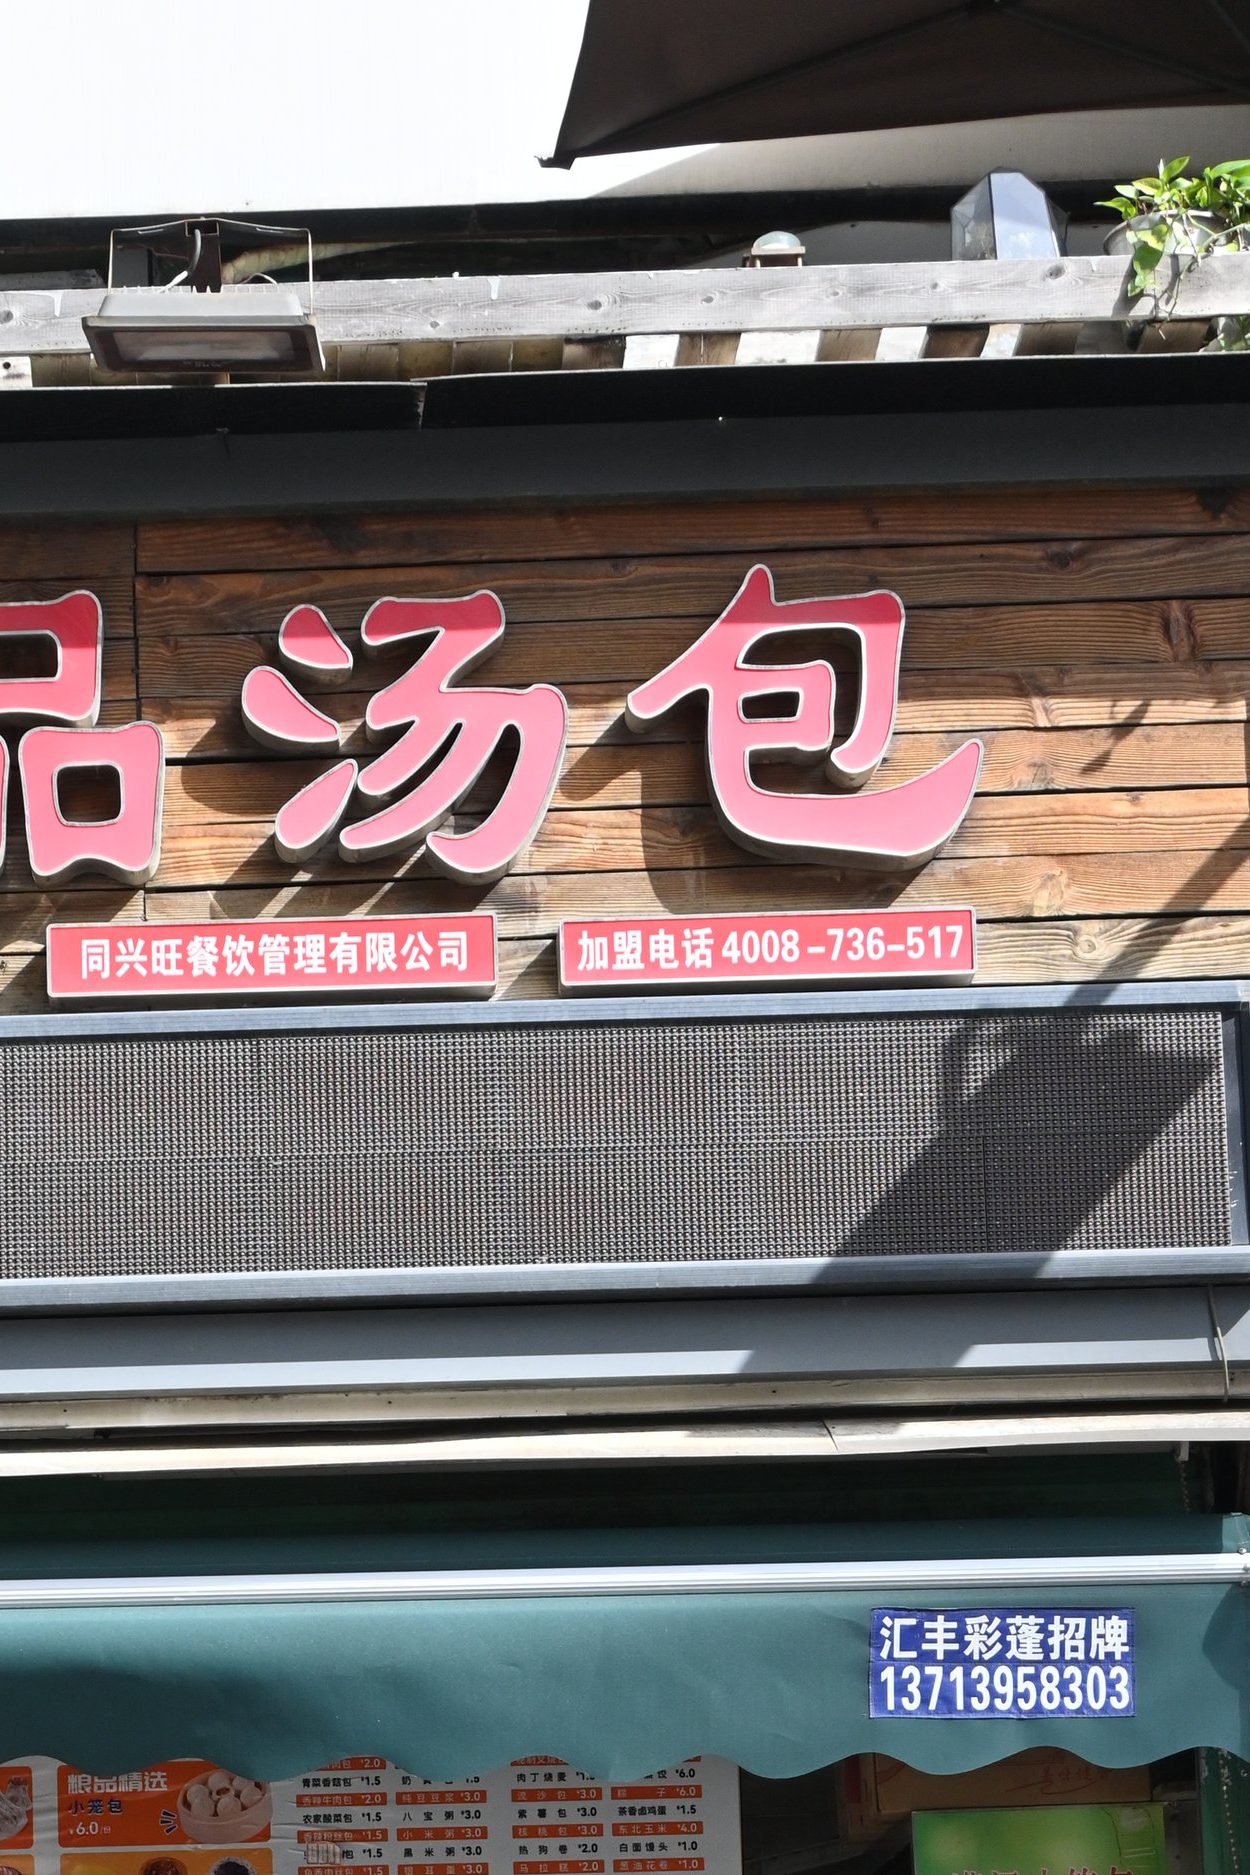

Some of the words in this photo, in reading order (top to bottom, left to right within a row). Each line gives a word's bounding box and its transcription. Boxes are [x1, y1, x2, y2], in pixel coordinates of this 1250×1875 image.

[78, 931, 470, 979] 同兴旺餐饮管理有限公司
[879, 1614, 1130, 1661] 汇丰彩蓬招牌
[879, 1664, 1131, 1711] 13713958303
[67, 1771, 168, 1794] 粮品精选
[302, 1776, 352, 1788] 青菜香菇包
[516, 1772, 567, 1783] 肉丁烧麦
[67, 1798, 123, 1816] 小笼包
[302, 1813, 353, 1824] 农家酸菜包
[402, 1810, 455, 1822] 八宝粥
[517, 1808, 567, 1819] 紫薯包
[402, 1830, 456, 1840] 小米粥
[403, 1846, 456, 1858] 黑米粥
[518, 1844, 568, 1855] 热狗卷
